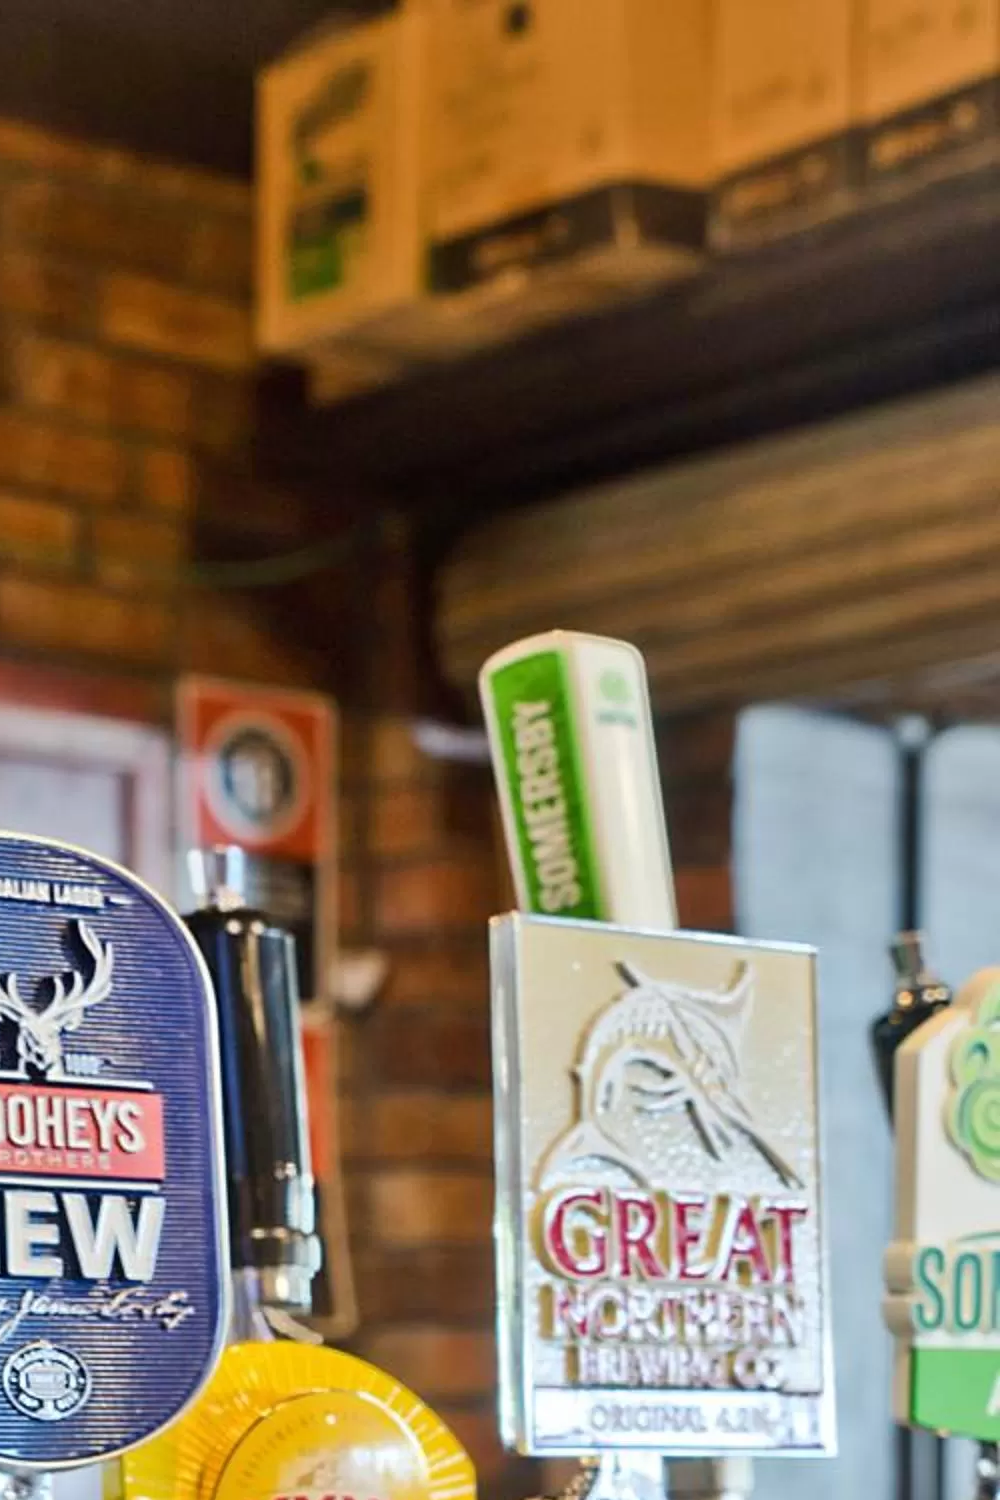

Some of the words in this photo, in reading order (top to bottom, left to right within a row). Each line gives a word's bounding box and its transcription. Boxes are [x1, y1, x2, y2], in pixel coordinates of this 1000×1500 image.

[511, 700, 583, 912] SOMERSBY
[52, 883, 105, 908] LAGER
[538, 1186, 809, 1284] GREAT
[913, 1246, 1000, 1331] SO
[590, 1403, 708, 1433] ORIGINAL
